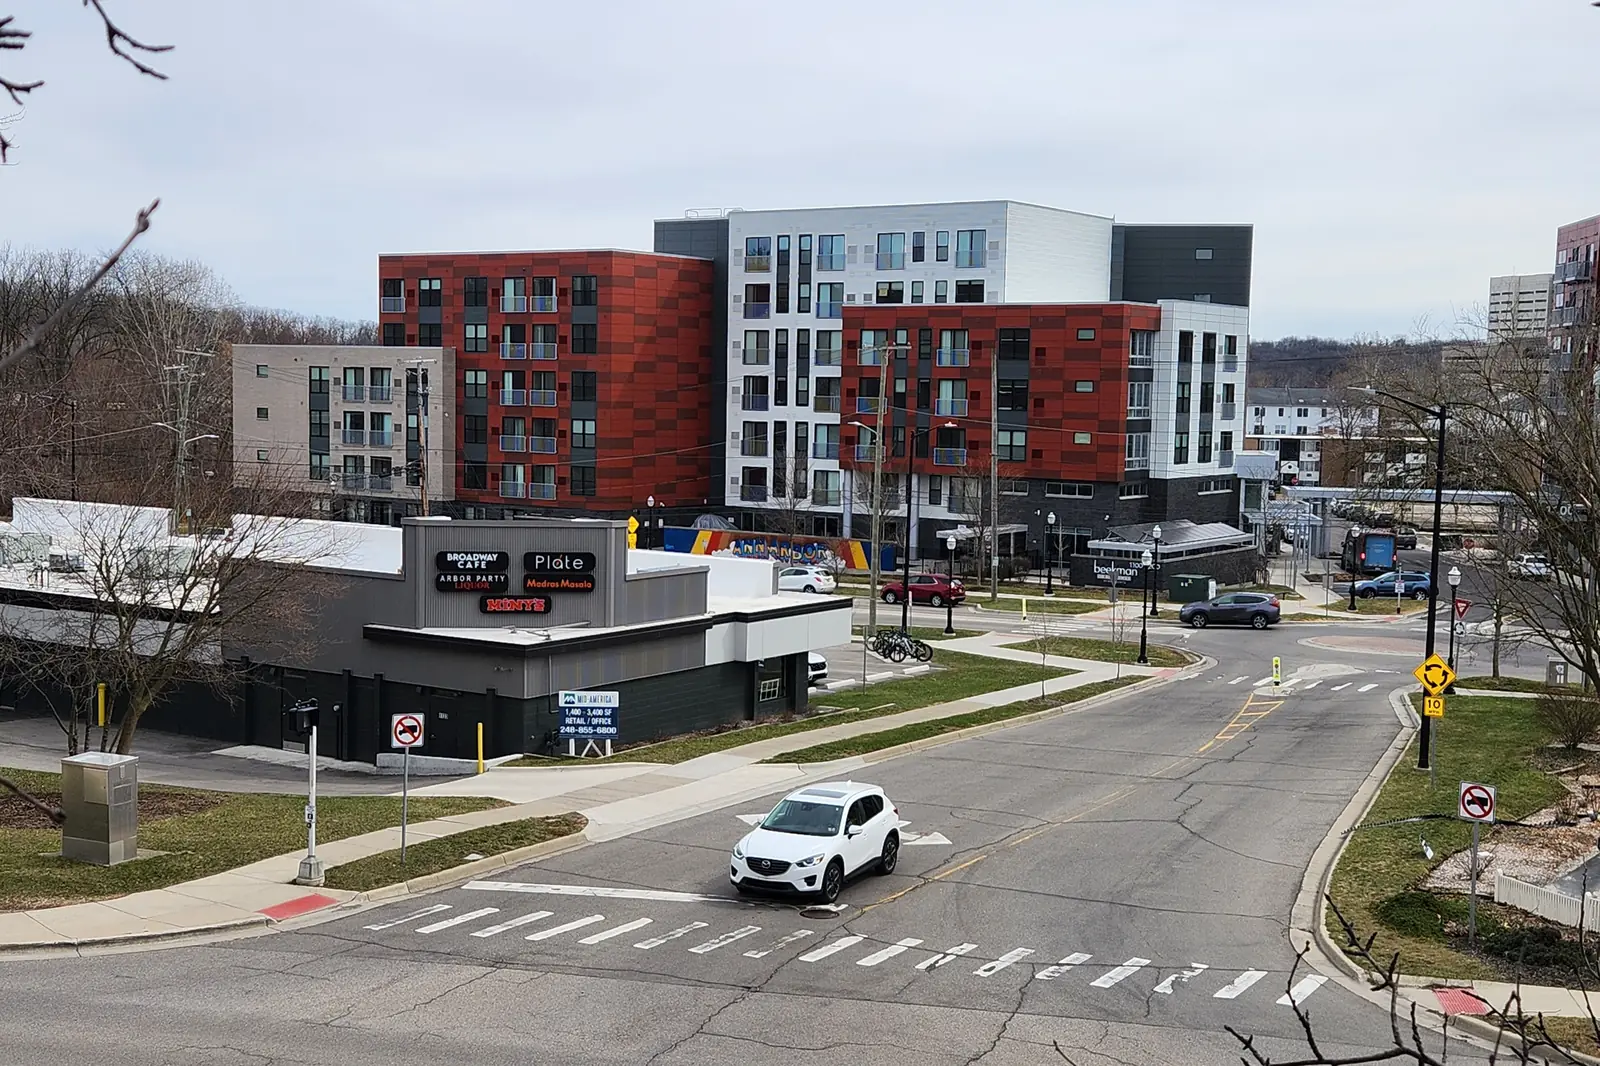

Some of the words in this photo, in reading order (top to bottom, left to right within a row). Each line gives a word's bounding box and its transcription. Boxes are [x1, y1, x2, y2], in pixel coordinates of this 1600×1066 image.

[447, 553, 498, 561] BROADWAY
[455, 582, 490, 590] LIQUOR
[527, 578, 559, 588] Madras
[560, 578, 592, 588] Masala
[1428, 699, 1441, 709] 10
[604, 708, 613, 716] SF
[565, 717, 586, 725] RETAIL
[591, 717, 612, 725] OFFICE
[560, 726, 617, 734] 248-855-6800
